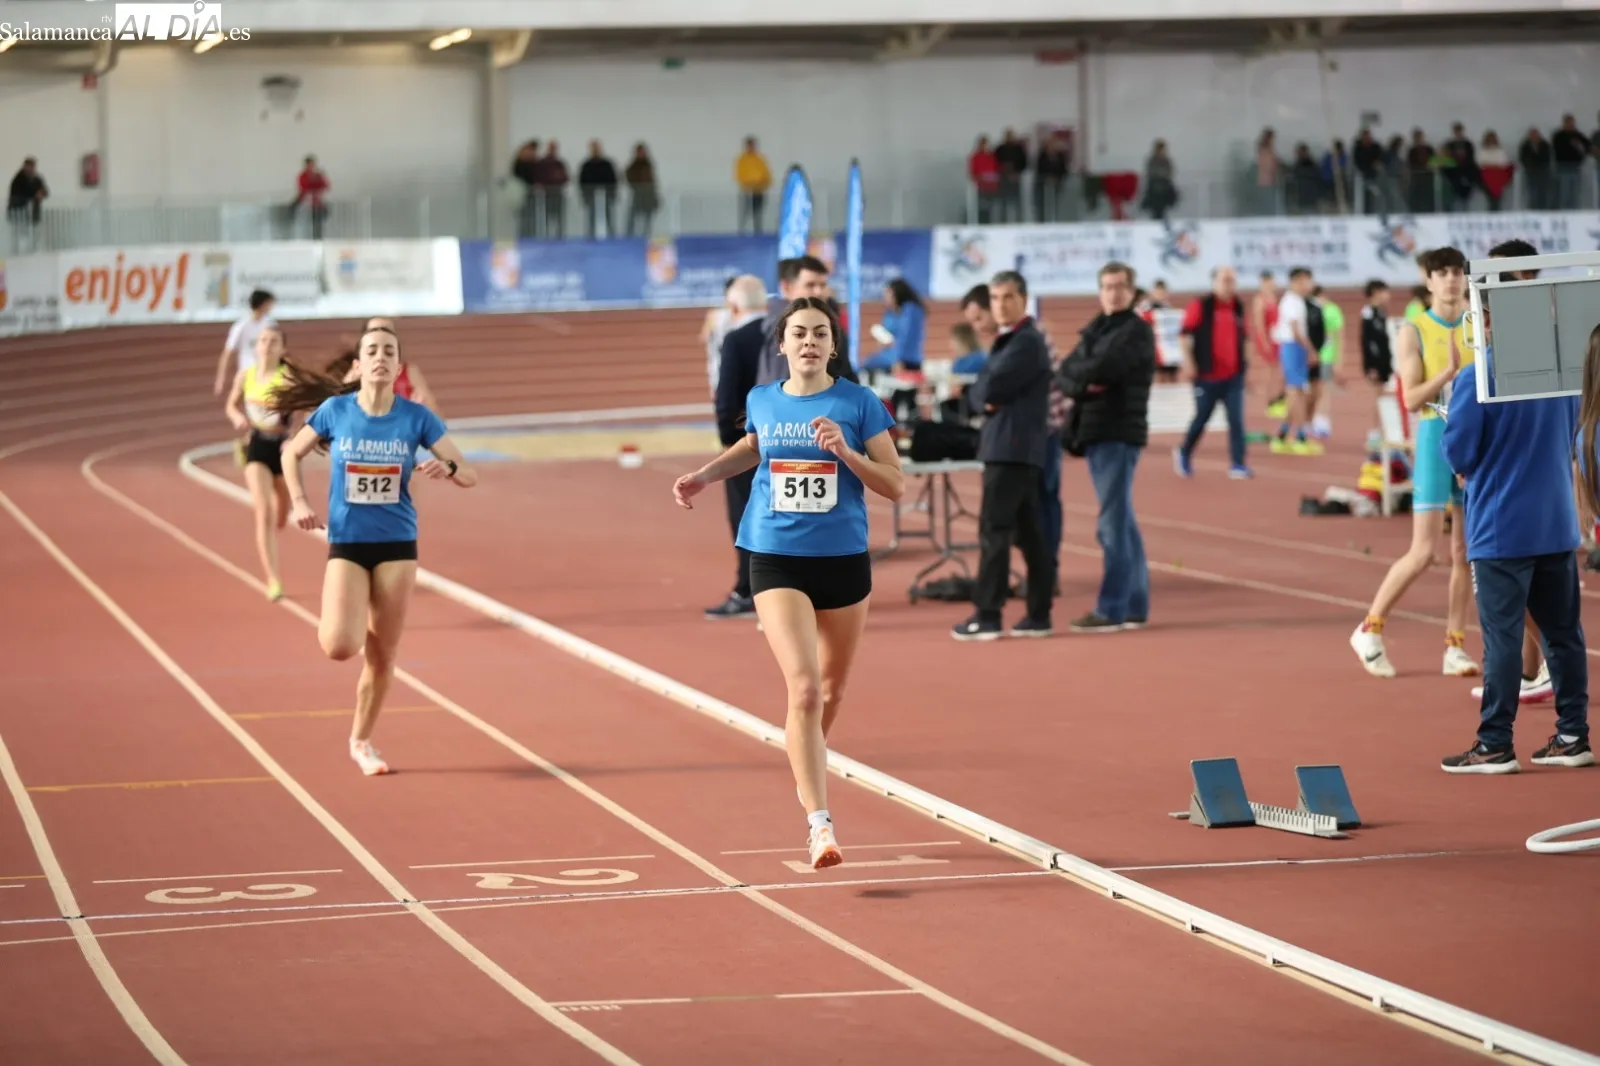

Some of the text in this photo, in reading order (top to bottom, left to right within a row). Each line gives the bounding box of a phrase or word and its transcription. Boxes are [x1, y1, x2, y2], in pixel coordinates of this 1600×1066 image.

[65, 252, 190, 314] enjoy!
[773, 422, 816, 438] ARMU
[340, 436, 409, 456] LA ARMUÑA
[357, 477, 392, 493] 512
[783, 477, 826, 499] 513
[466, 868, 639, 889] 2
[145, 883, 317, 905] 3
